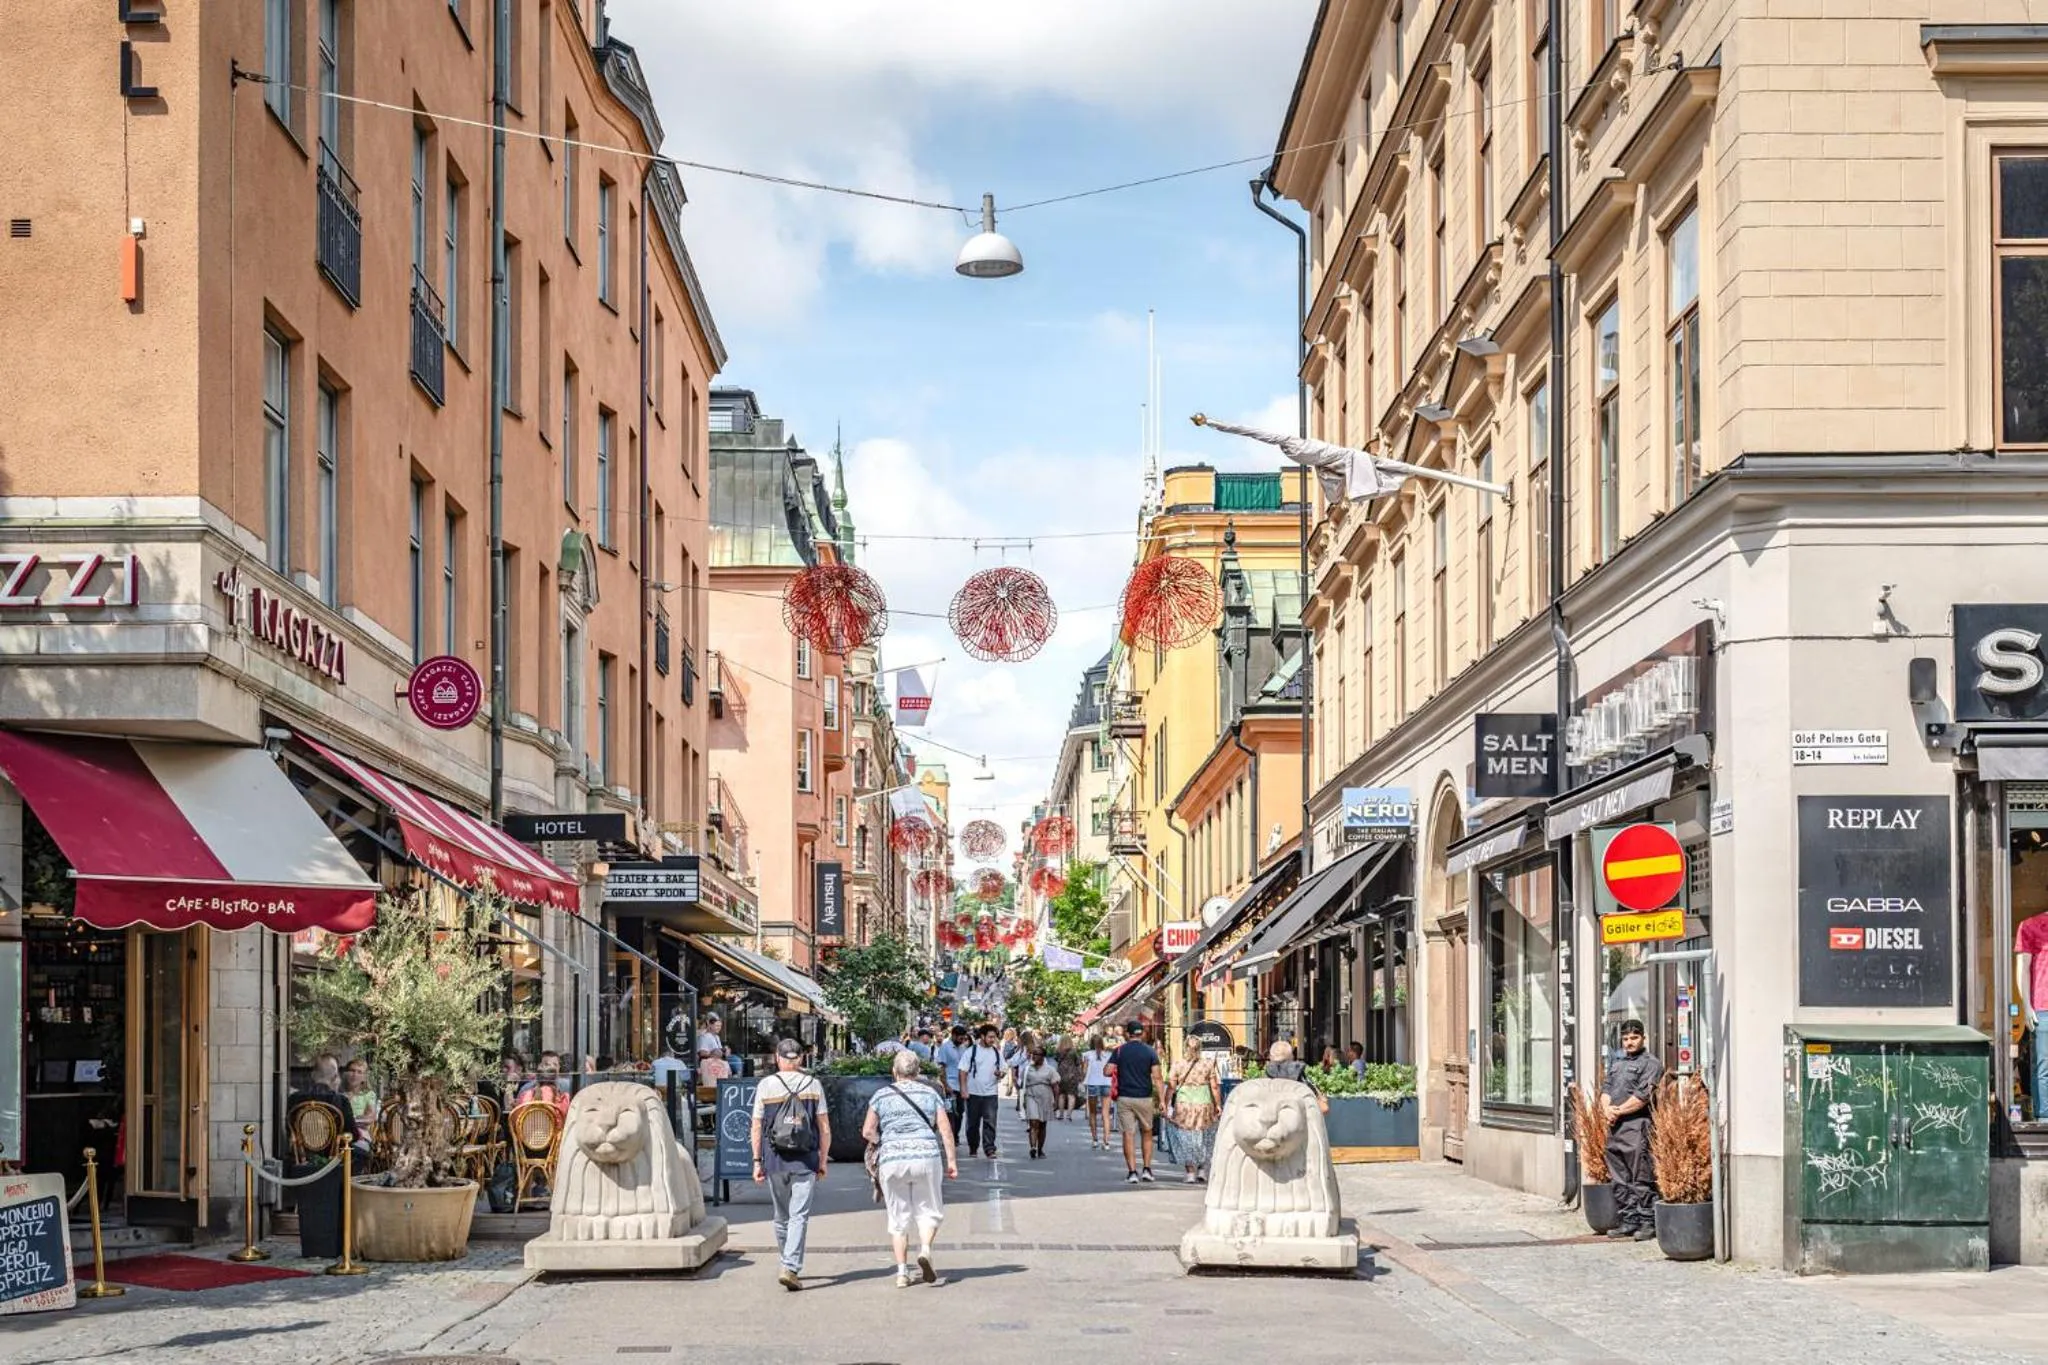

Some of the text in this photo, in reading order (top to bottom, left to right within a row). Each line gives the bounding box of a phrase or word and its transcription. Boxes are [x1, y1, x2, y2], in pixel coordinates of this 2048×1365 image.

[252, 587, 346, 686] RAGAZZI
[1977, 627, 2045, 693] S
[1483, 734, 1553, 752] SALT
[1794, 733, 1882, 744] Olof Palmes Gata
[1795, 750, 1822, 760] 18-14
[1487, 757, 1549, 775] MEN
[1347, 802, 1409, 820] NERO
[1580, 795, 1604, 828] SALT
[1827, 808, 1922, 829] REPLAY
[534, 821, 587, 835] HOTEL
[611, 874, 685, 884] TEATER & BAR
[611, 888, 686, 898] GREASY SPOON
[821, 873, 838, 925] Insurely
[1827, 897, 1924, 912] GABBA
[1606, 920, 1656, 935] Gäller ej
[1864, 928, 1923, 950] DIESEL
[0, 1220, 48, 1242] PRITZ
